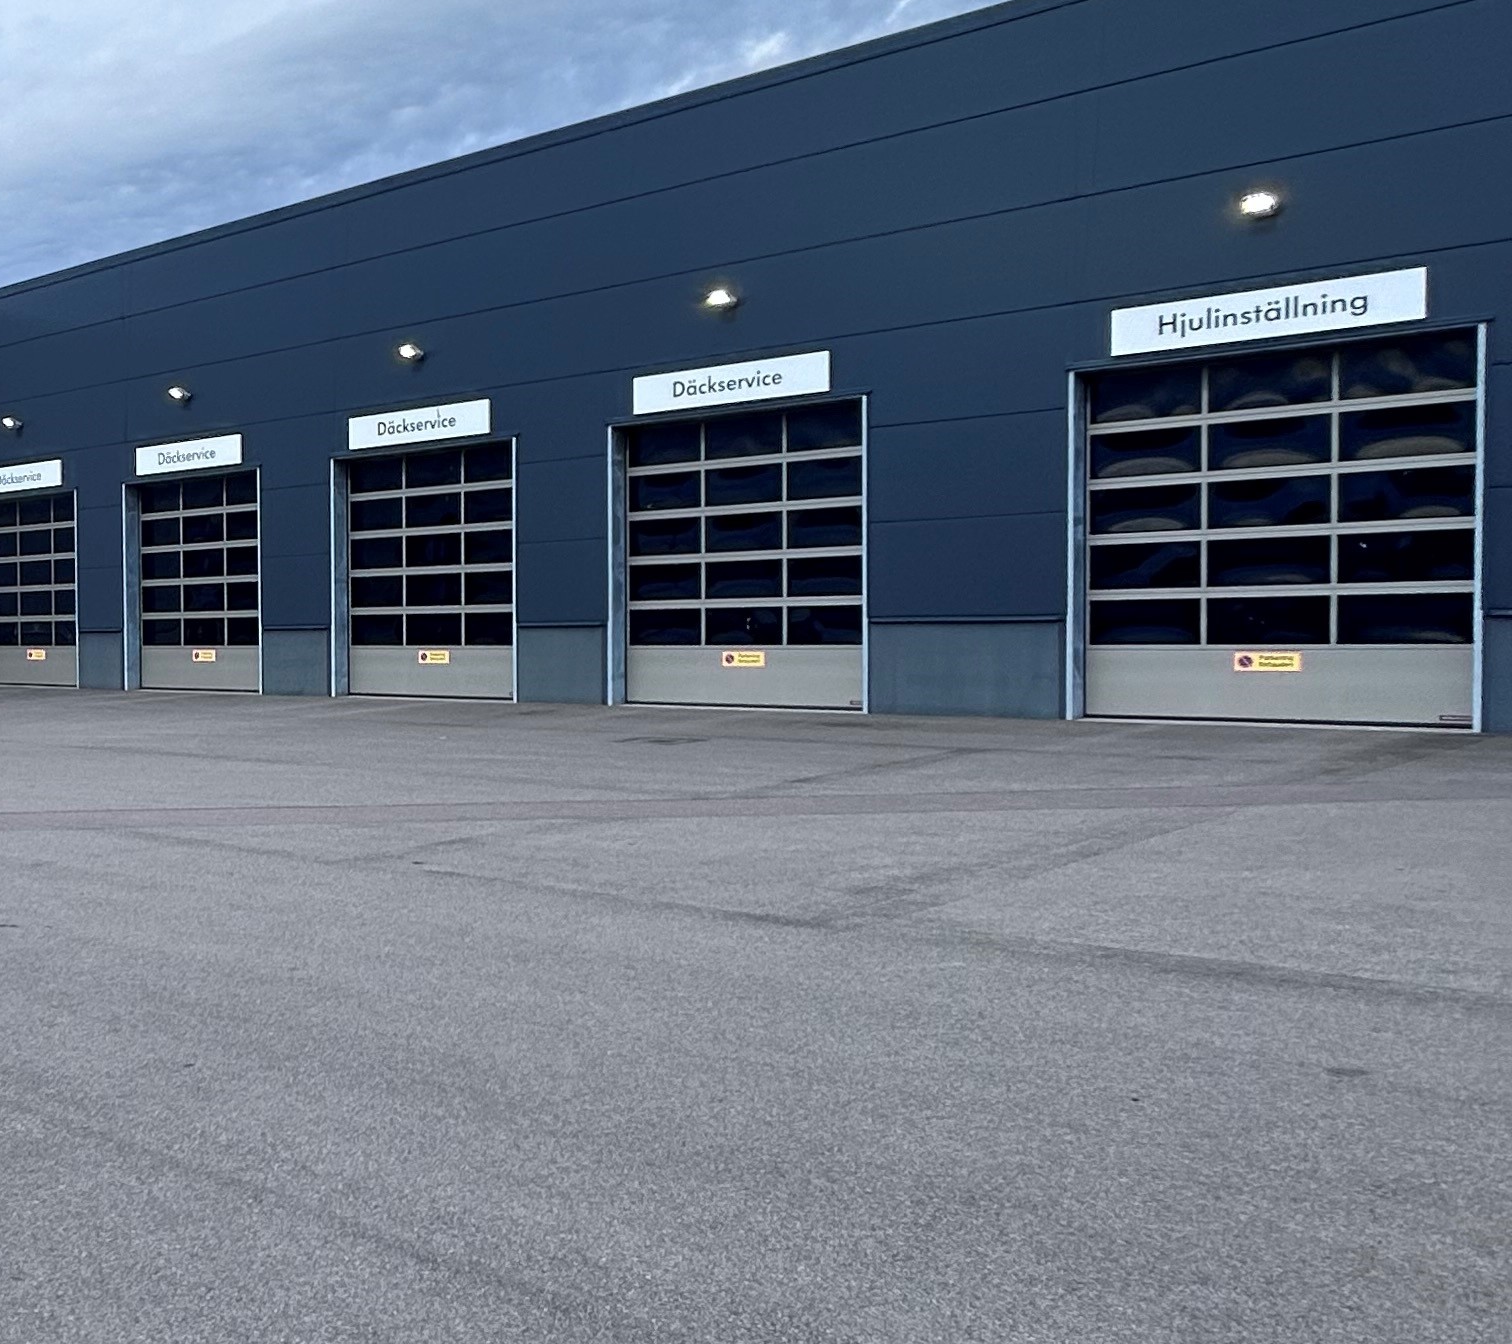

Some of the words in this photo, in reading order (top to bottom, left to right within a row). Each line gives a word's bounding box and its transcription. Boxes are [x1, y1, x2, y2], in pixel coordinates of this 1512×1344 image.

[1157, 293, 1369, 338] Hjulinställning
[672, 369, 783, 400] Däckservice
[376, 413, 457, 437] Däckservice
[157, 446, 217, 466] Däckservice
